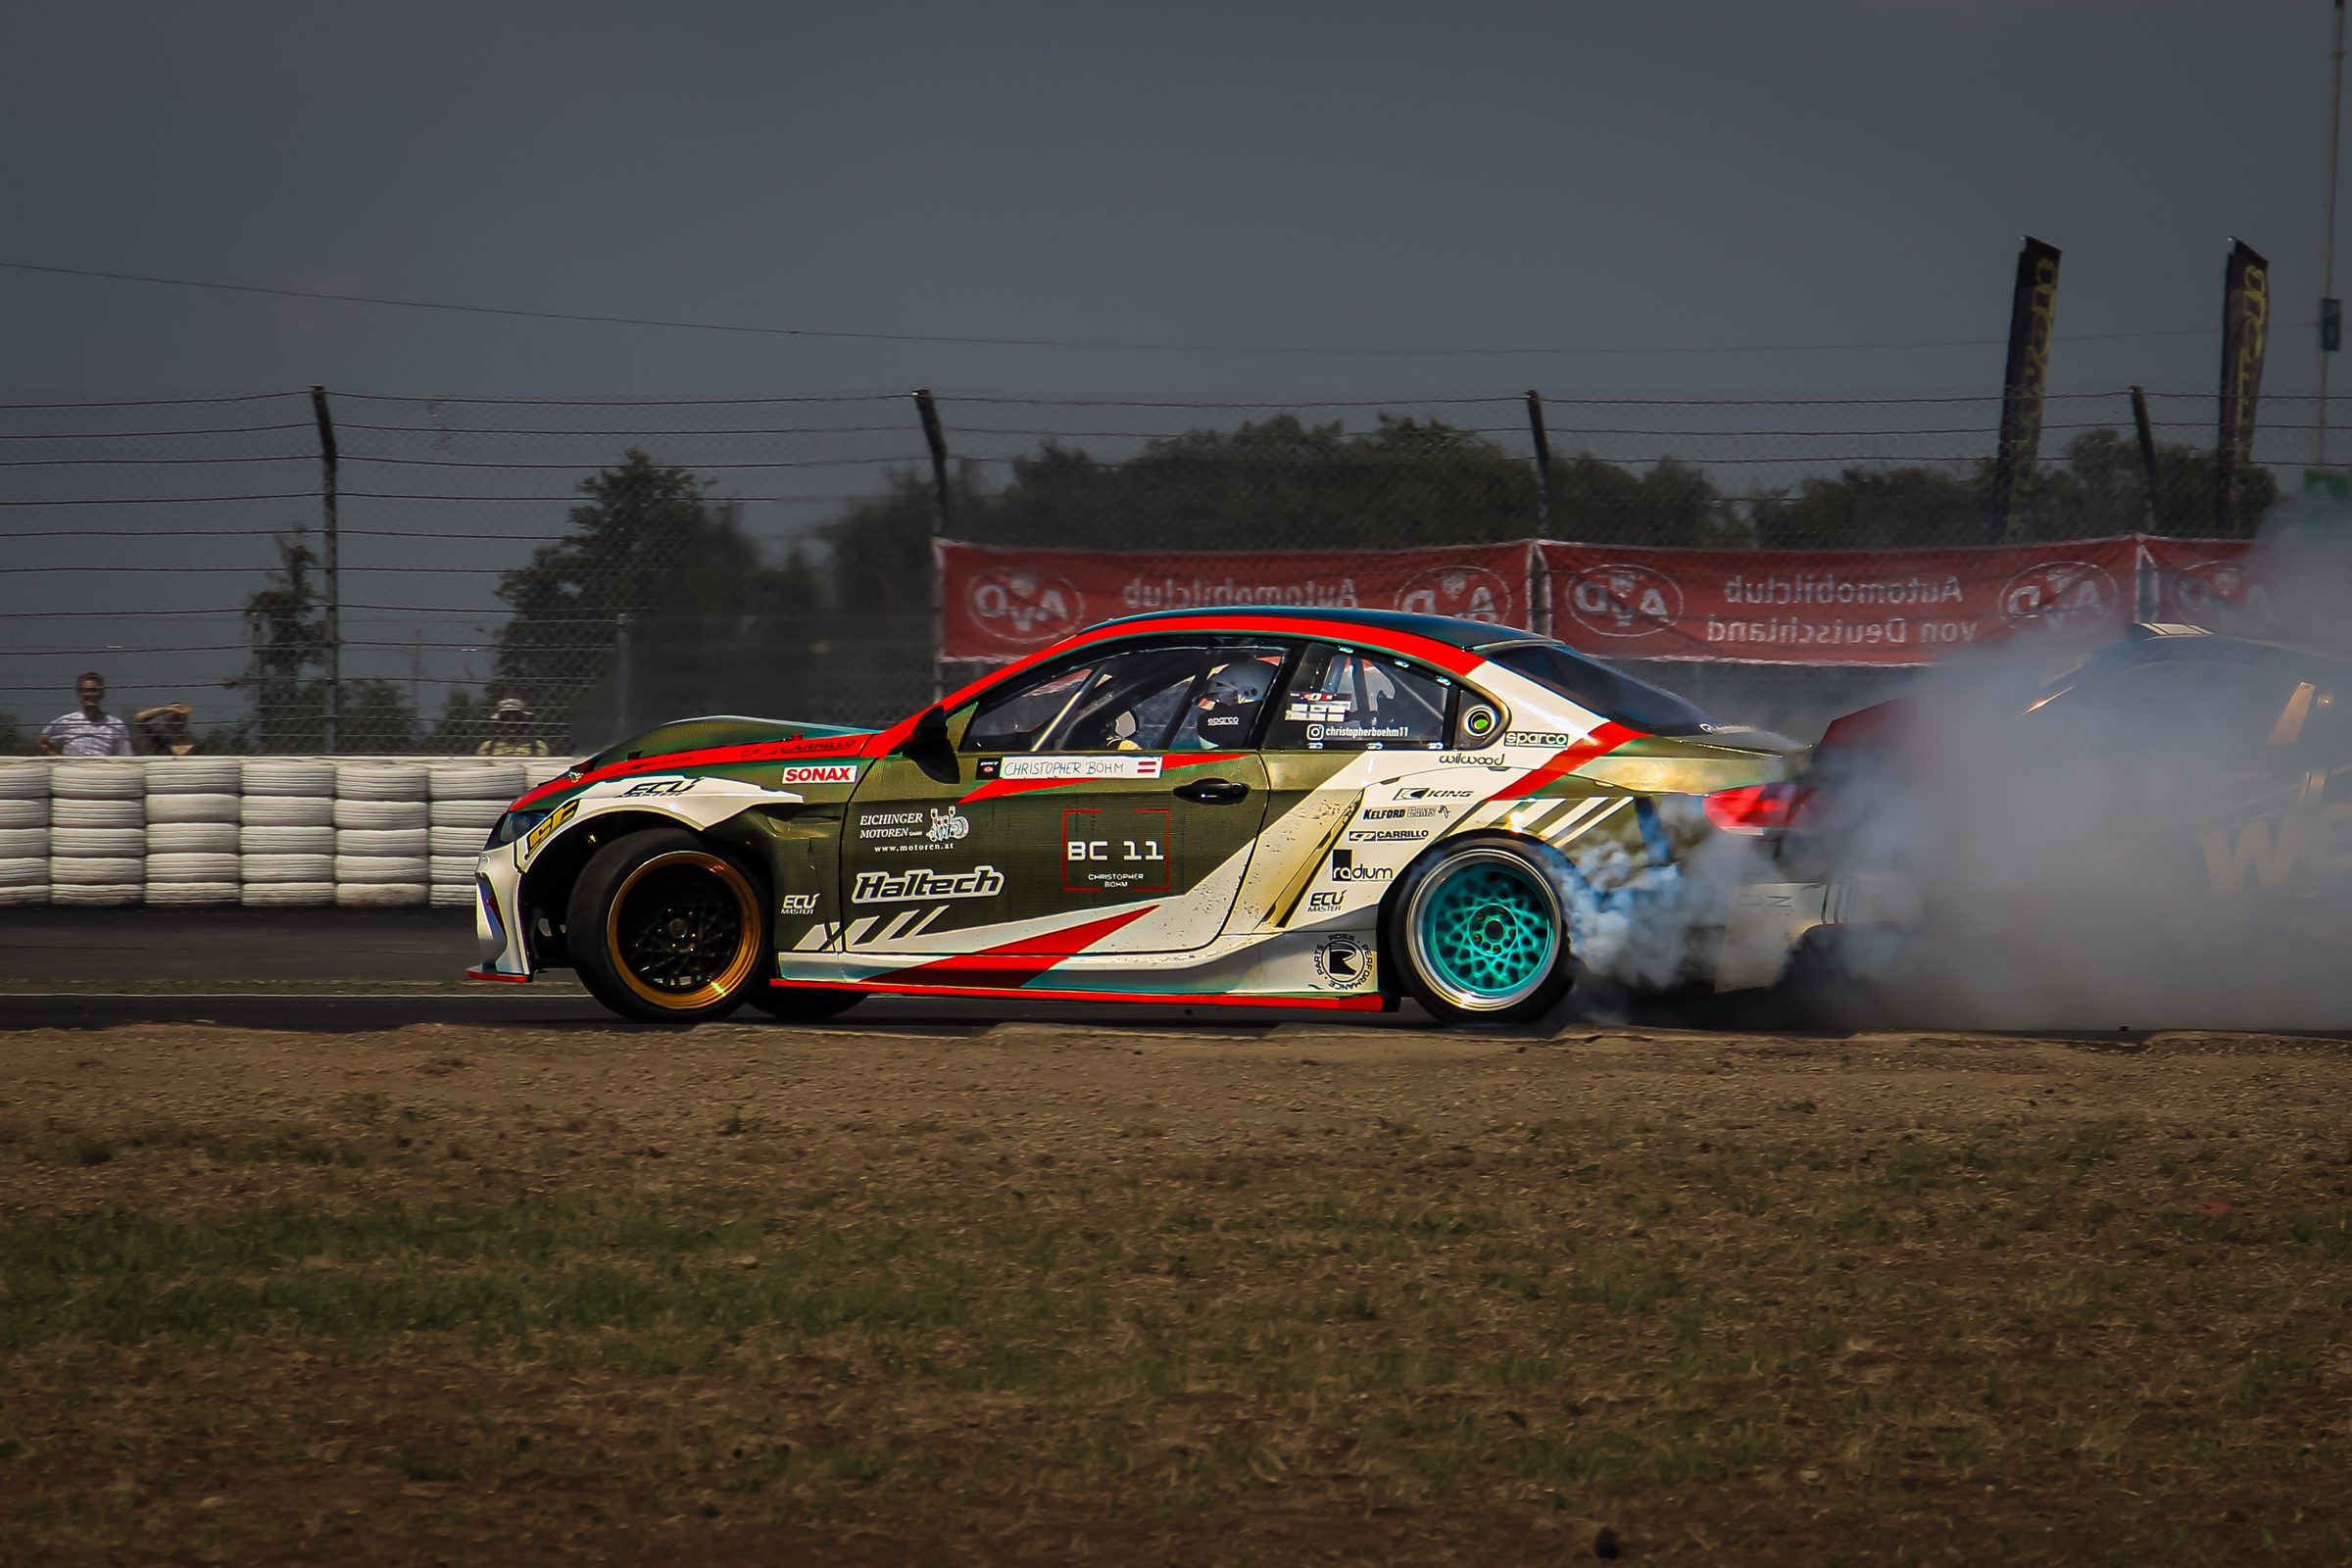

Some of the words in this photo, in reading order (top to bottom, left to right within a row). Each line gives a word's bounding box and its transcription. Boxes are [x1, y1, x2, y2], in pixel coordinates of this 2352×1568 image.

[1325, 726, 1409, 739] christopherboehm11
[1505, 732, 1568, 748] sparco
[1439, 754, 1505, 765] wilwood
[785, 767, 851, 782] SONAX
[1004, 761, 1082, 776] CHRISTOPHER
[859, 812, 923, 825] EICHINGER
[1363, 808, 1406, 820] KELFORD
[859, 827, 908, 839] MOTOREN
[1377, 829, 1430, 839] CARRILLO
[874, 843, 955, 853] www.motoren.at
[1067, 841, 1108, 861] BC
[1123, 840, 1164, 860] 11
[1333, 862, 1394, 880] radium
[854, 867, 1003, 902] Haltech
[783, 893, 820, 909] ECU
[1309, 890, 1348, 906] ECU
[1313, 943, 1325, 976] PARTS
